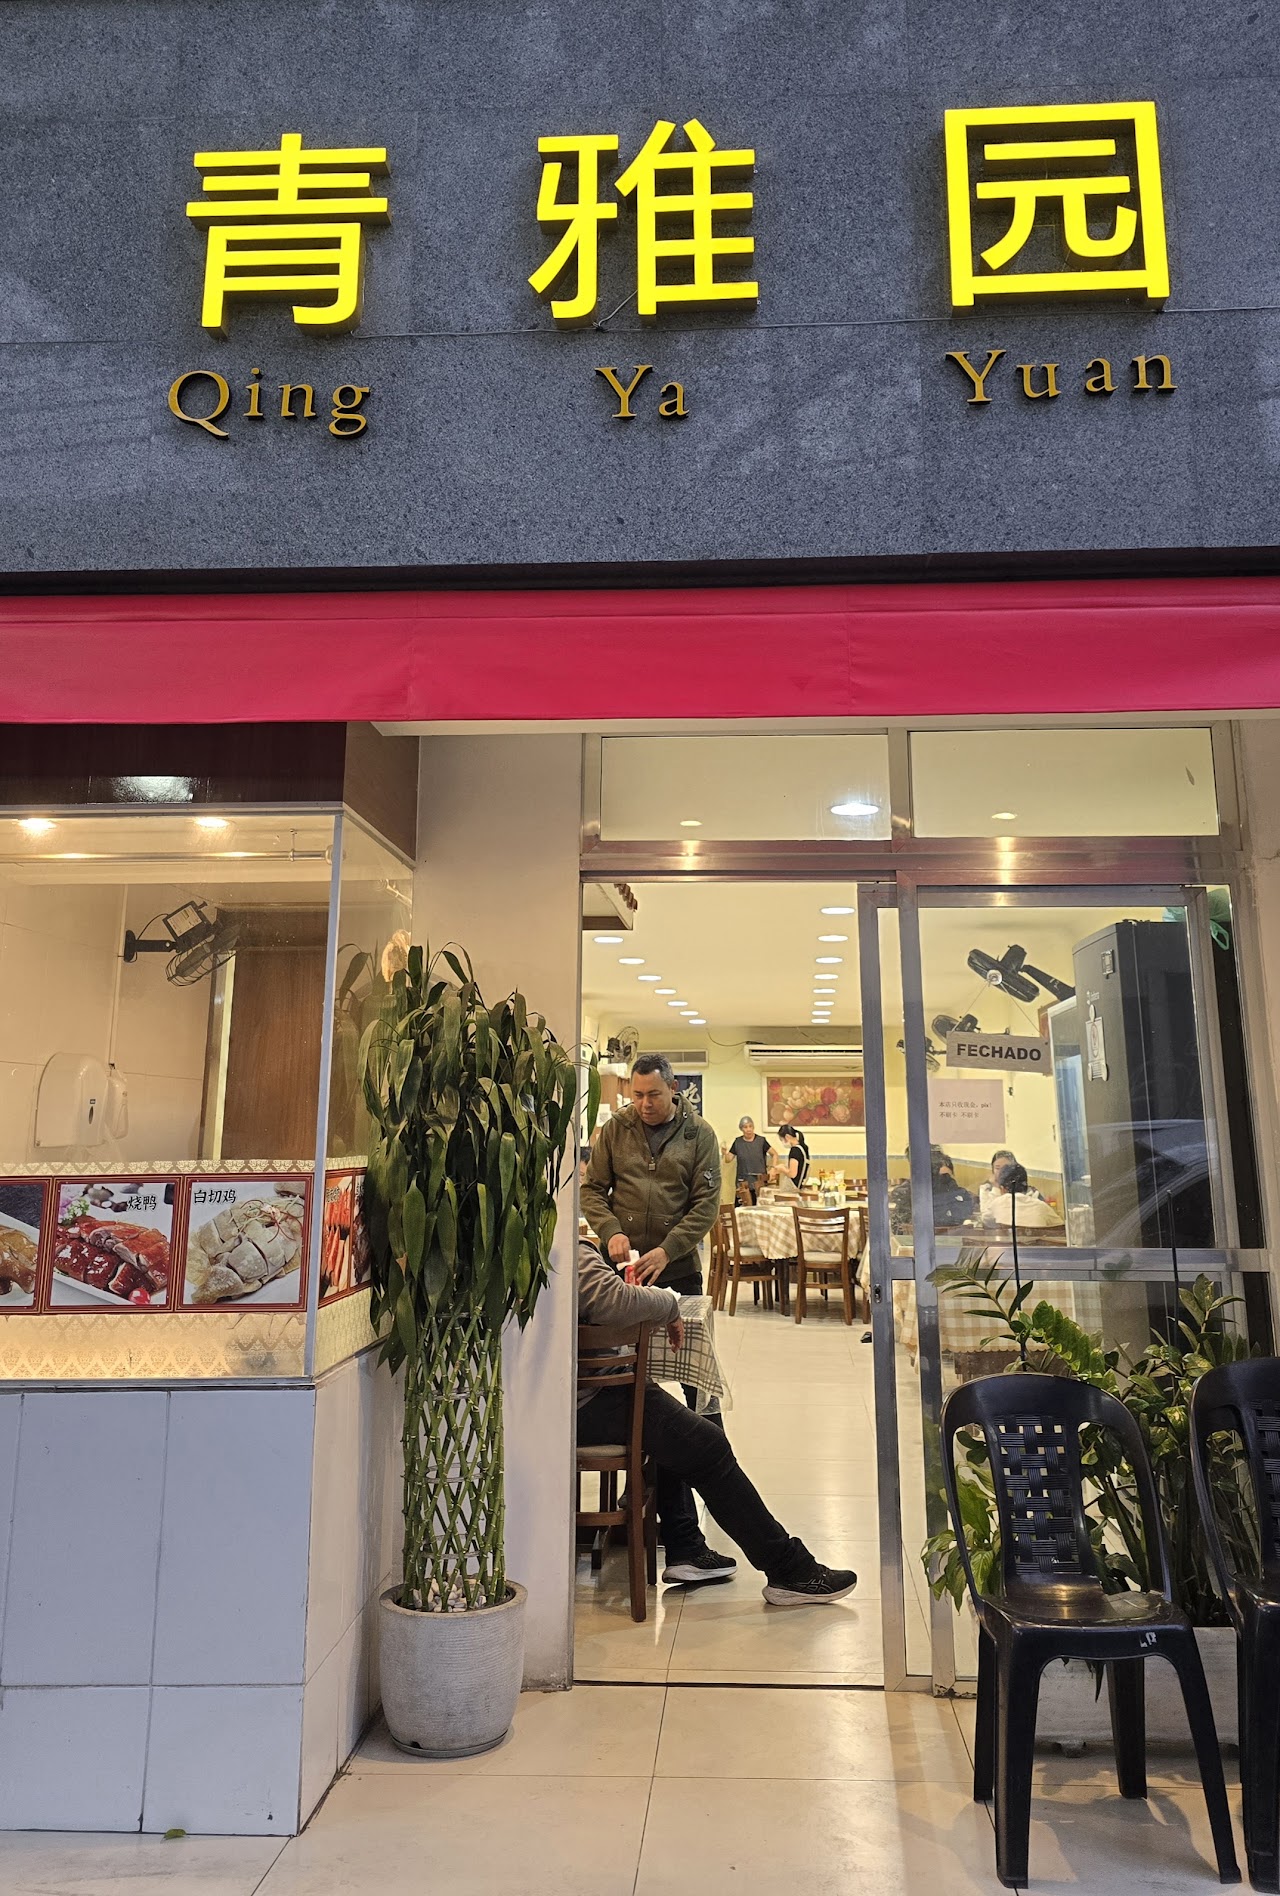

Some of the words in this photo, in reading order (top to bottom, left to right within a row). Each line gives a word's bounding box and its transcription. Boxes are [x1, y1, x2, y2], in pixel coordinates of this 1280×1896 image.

[186, 101, 1170, 338] 青雅园
[168, 367, 370, 439] Qing
[595, 365, 690, 420] Ya
[945, 349, 1178, 404] Yuan
[956, 1043, 1042, 1061] FECHADO
[127, 1195, 157, 1211] 烧鸭
[194, 1189, 237, 1204] 白切鸡
